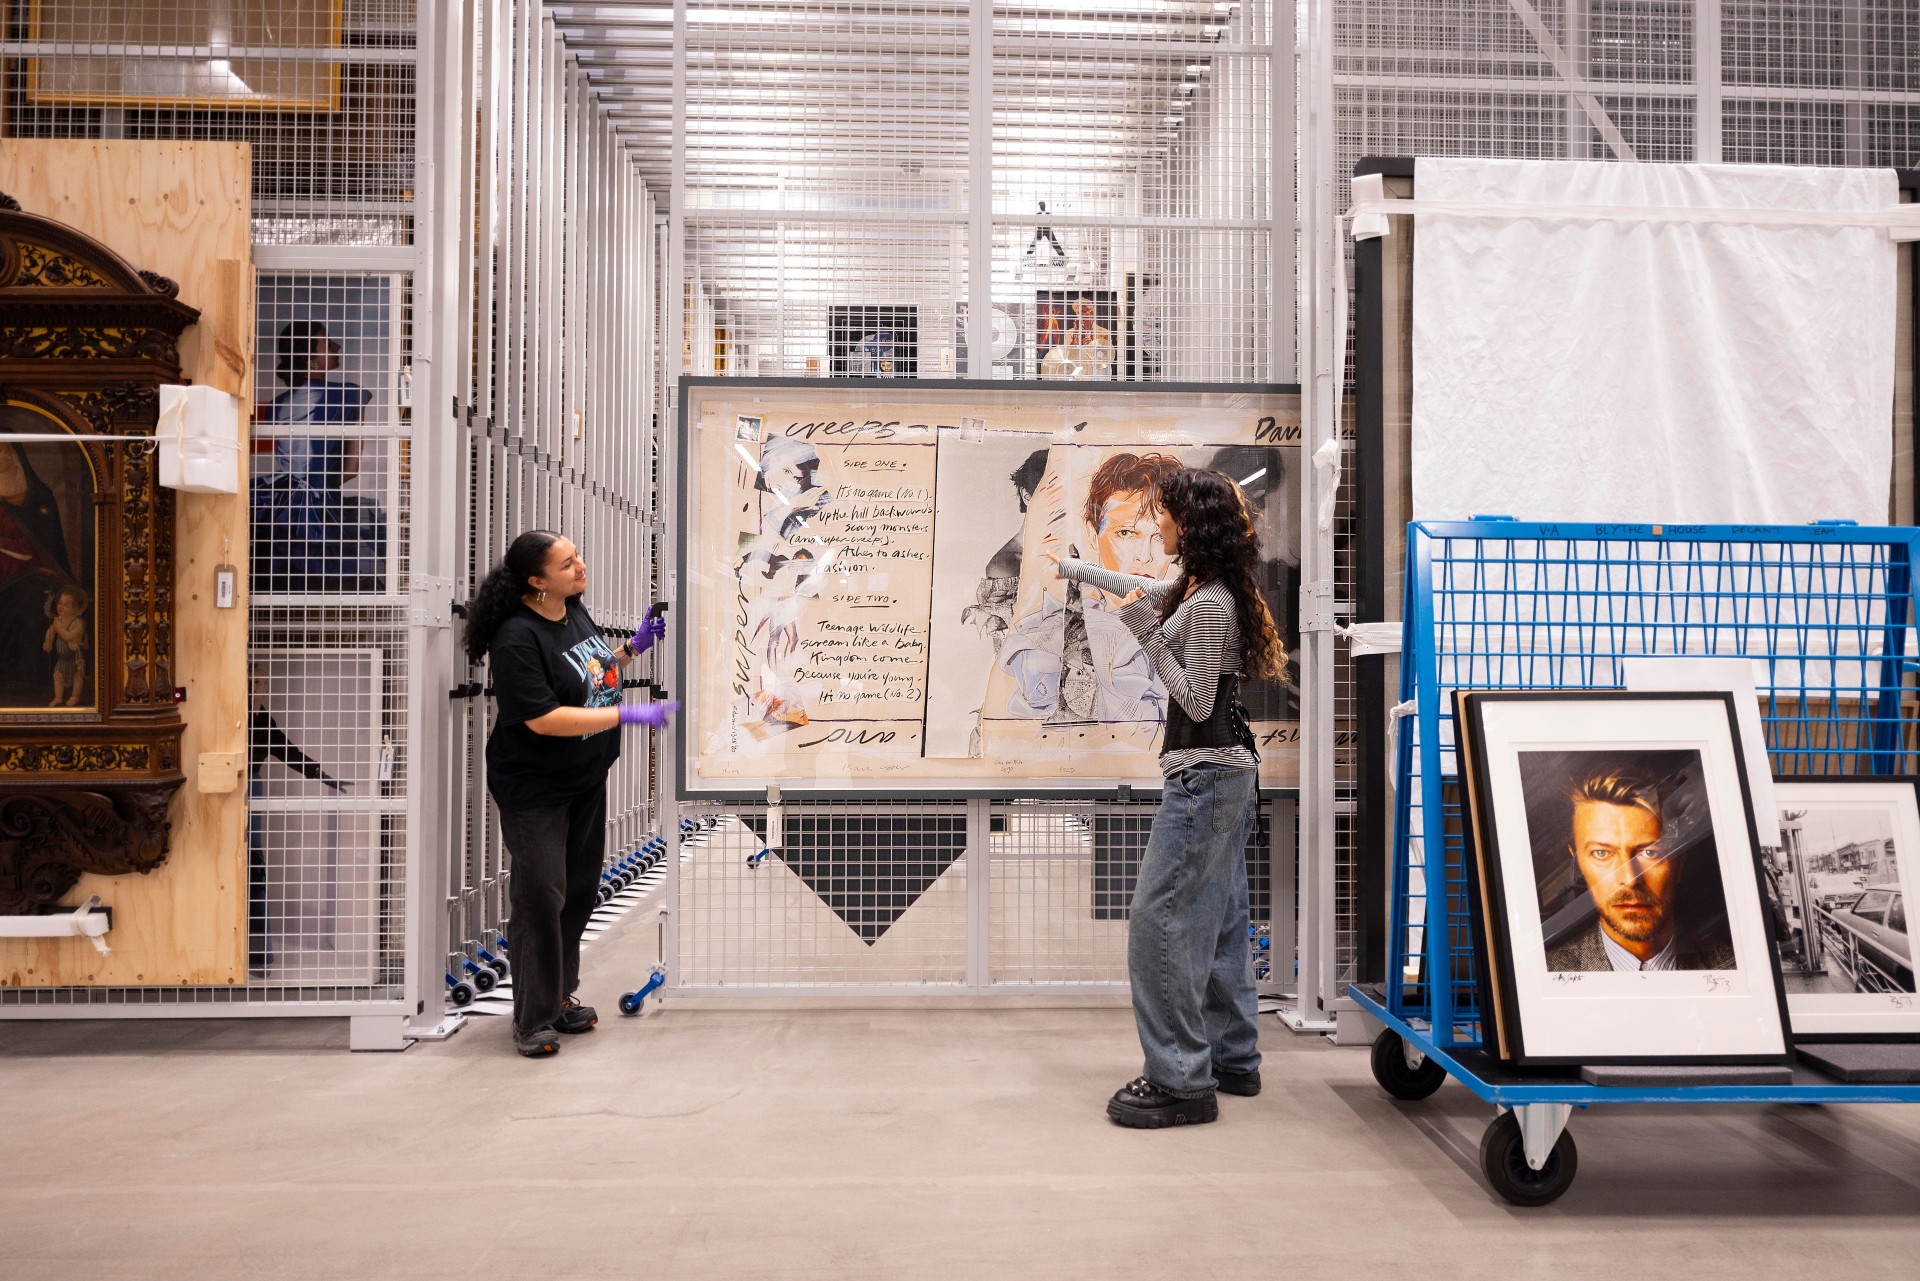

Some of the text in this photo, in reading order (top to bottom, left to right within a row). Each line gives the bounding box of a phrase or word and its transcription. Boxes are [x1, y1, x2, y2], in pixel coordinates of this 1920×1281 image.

[843, 460, 867, 468] SIDE
[853, 488, 865, 498] no
[867, 489, 893, 501] game
[832, 508, 848, 520] the
[851, 505, 869, 520] hill
[1595, 525, 1645, 536] BLYTHE
[1668, 525, 1706, 535] HOUSE
[1731, 527, 1781, 535] DECANT
[837, 546, 873, 559] Ashes
[877, 549, 888, 558] to
[832, 595, 861, 603] SIDE
[817, 620, 865, 635] Teenage
[852, 636, 878, 648] like
[810, 651, 867, 666] Kingdom
[794, 667, 841, 683] Because
[854, 693, 883, 704] game
